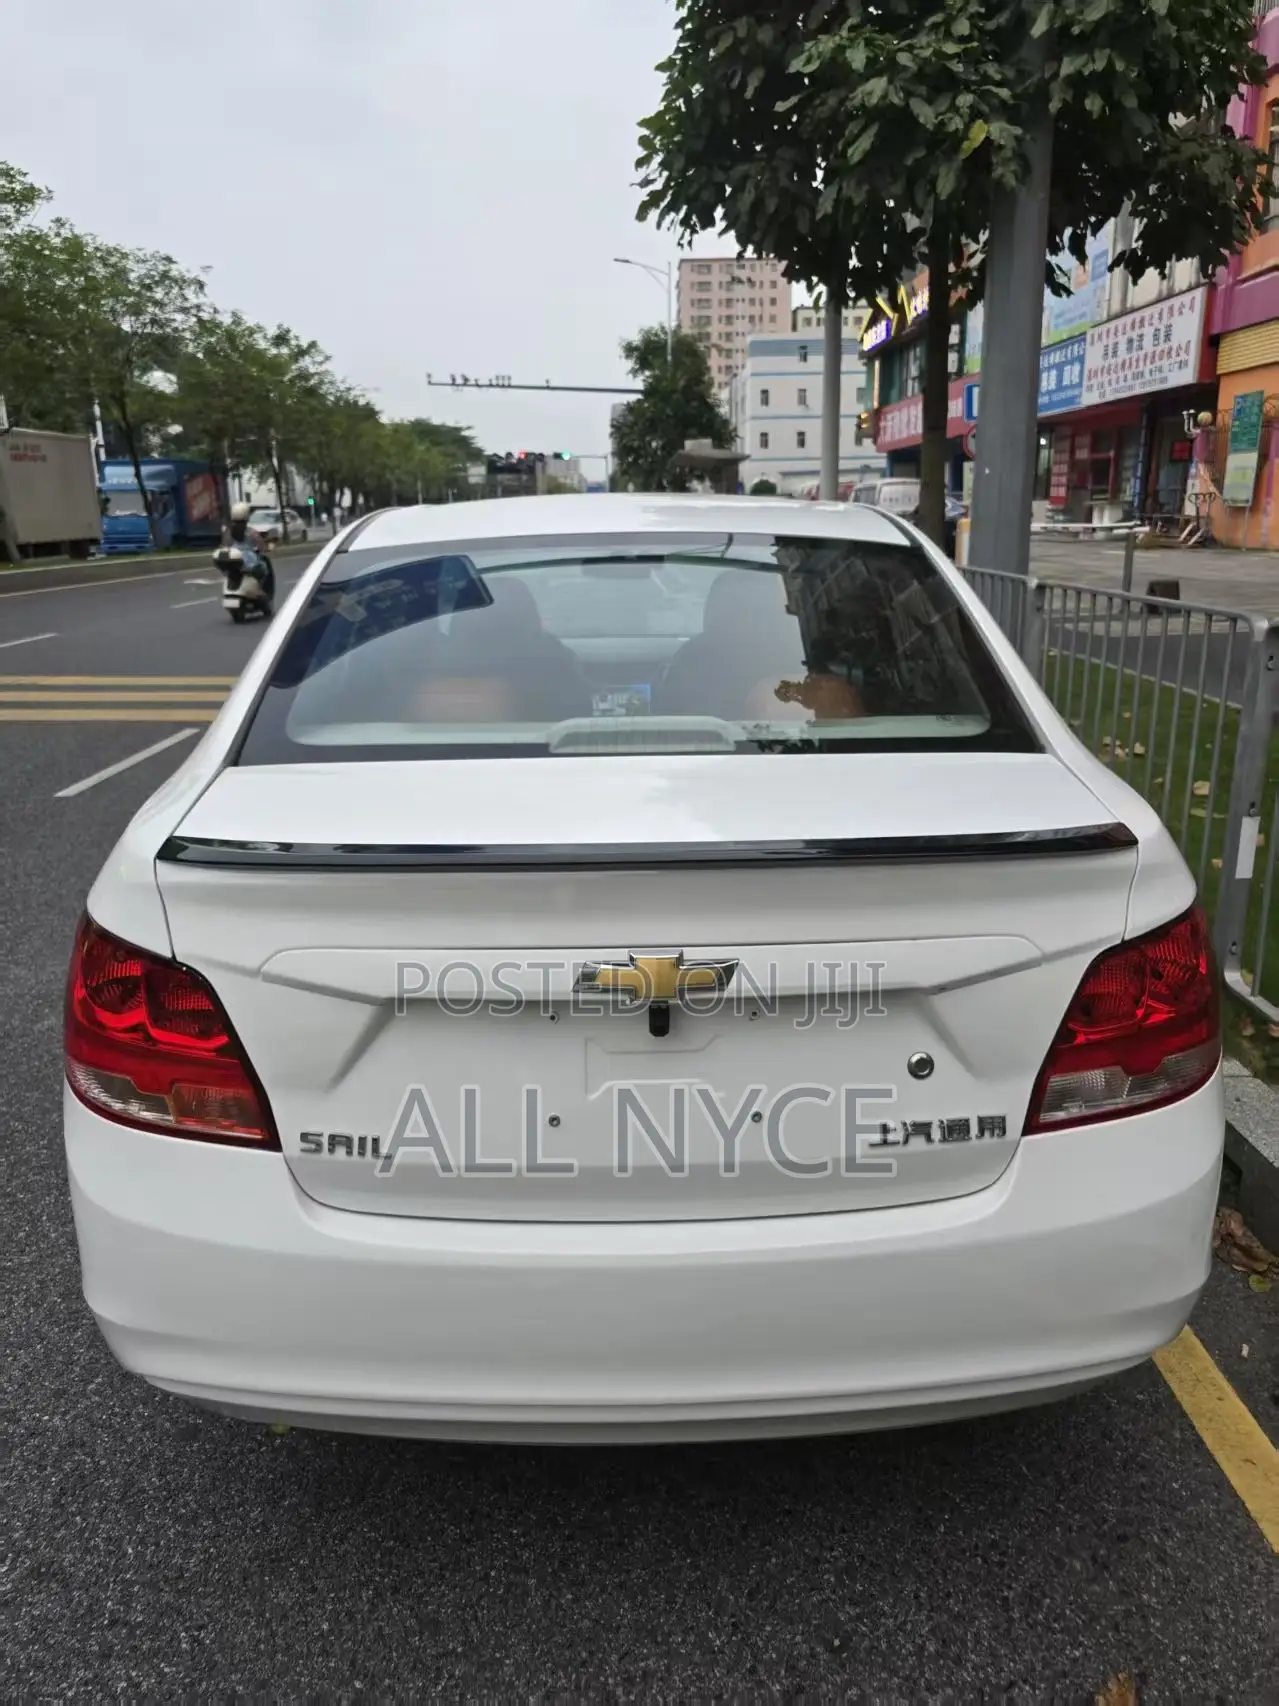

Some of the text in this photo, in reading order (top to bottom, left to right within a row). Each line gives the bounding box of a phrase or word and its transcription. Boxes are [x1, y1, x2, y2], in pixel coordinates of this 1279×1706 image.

[300, 1132, 393, 1160] SAIL
[868, 1115, 1007, 1147] 上汽通用
